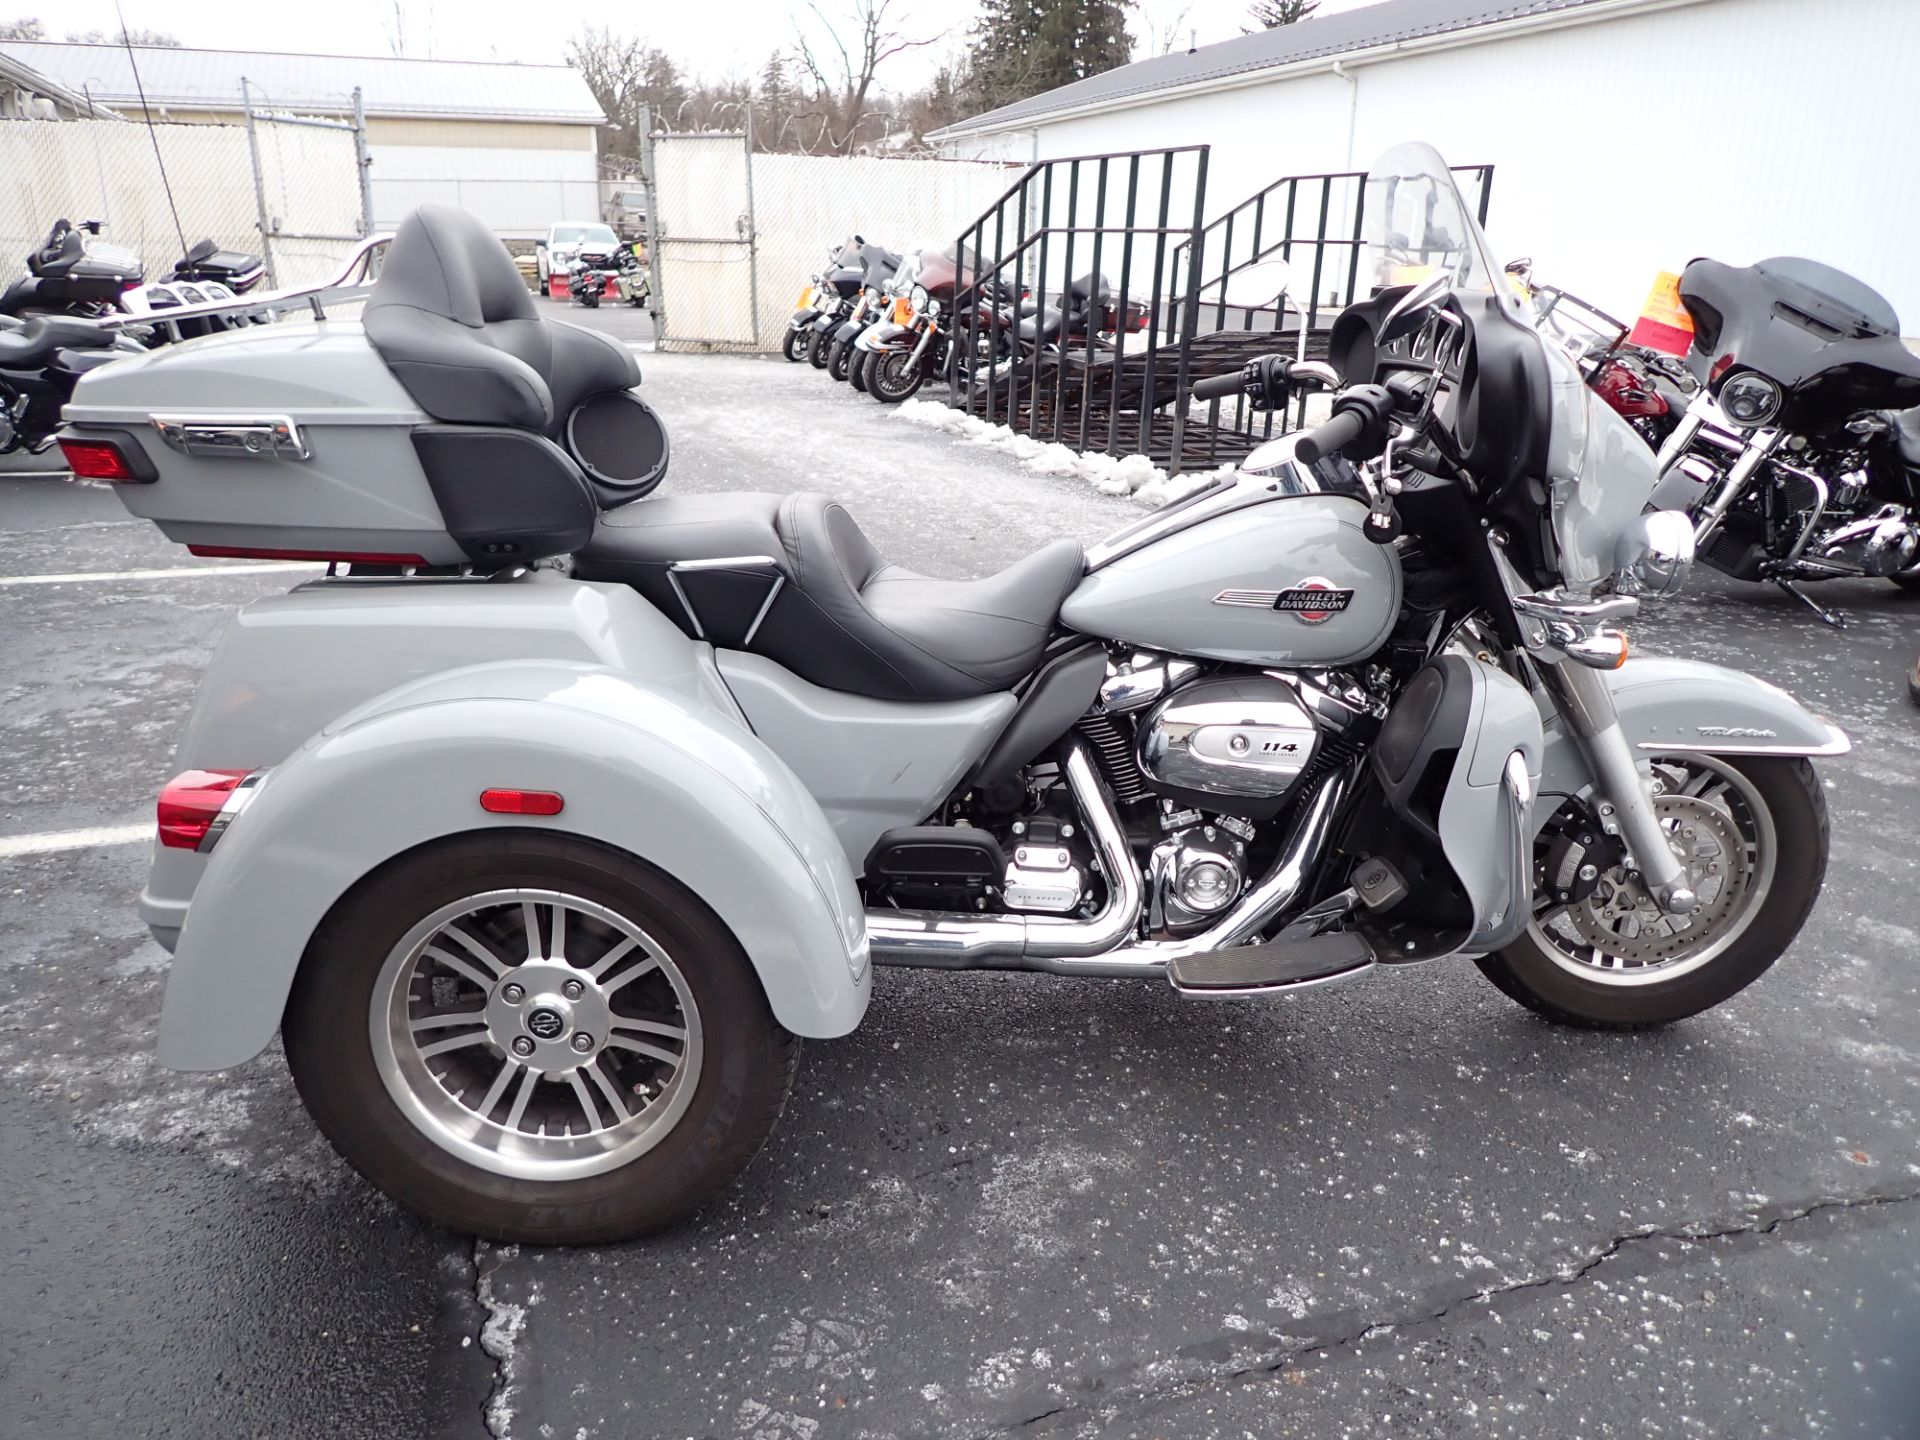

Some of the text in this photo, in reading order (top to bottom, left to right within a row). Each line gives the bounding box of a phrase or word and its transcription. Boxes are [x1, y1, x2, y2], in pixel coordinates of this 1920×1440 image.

[1286, 592, 1345, 601] HARLEY-
[1279, 600, 1346, 609] DAVIDSON
[1262, 742, 1298, 752] 114
